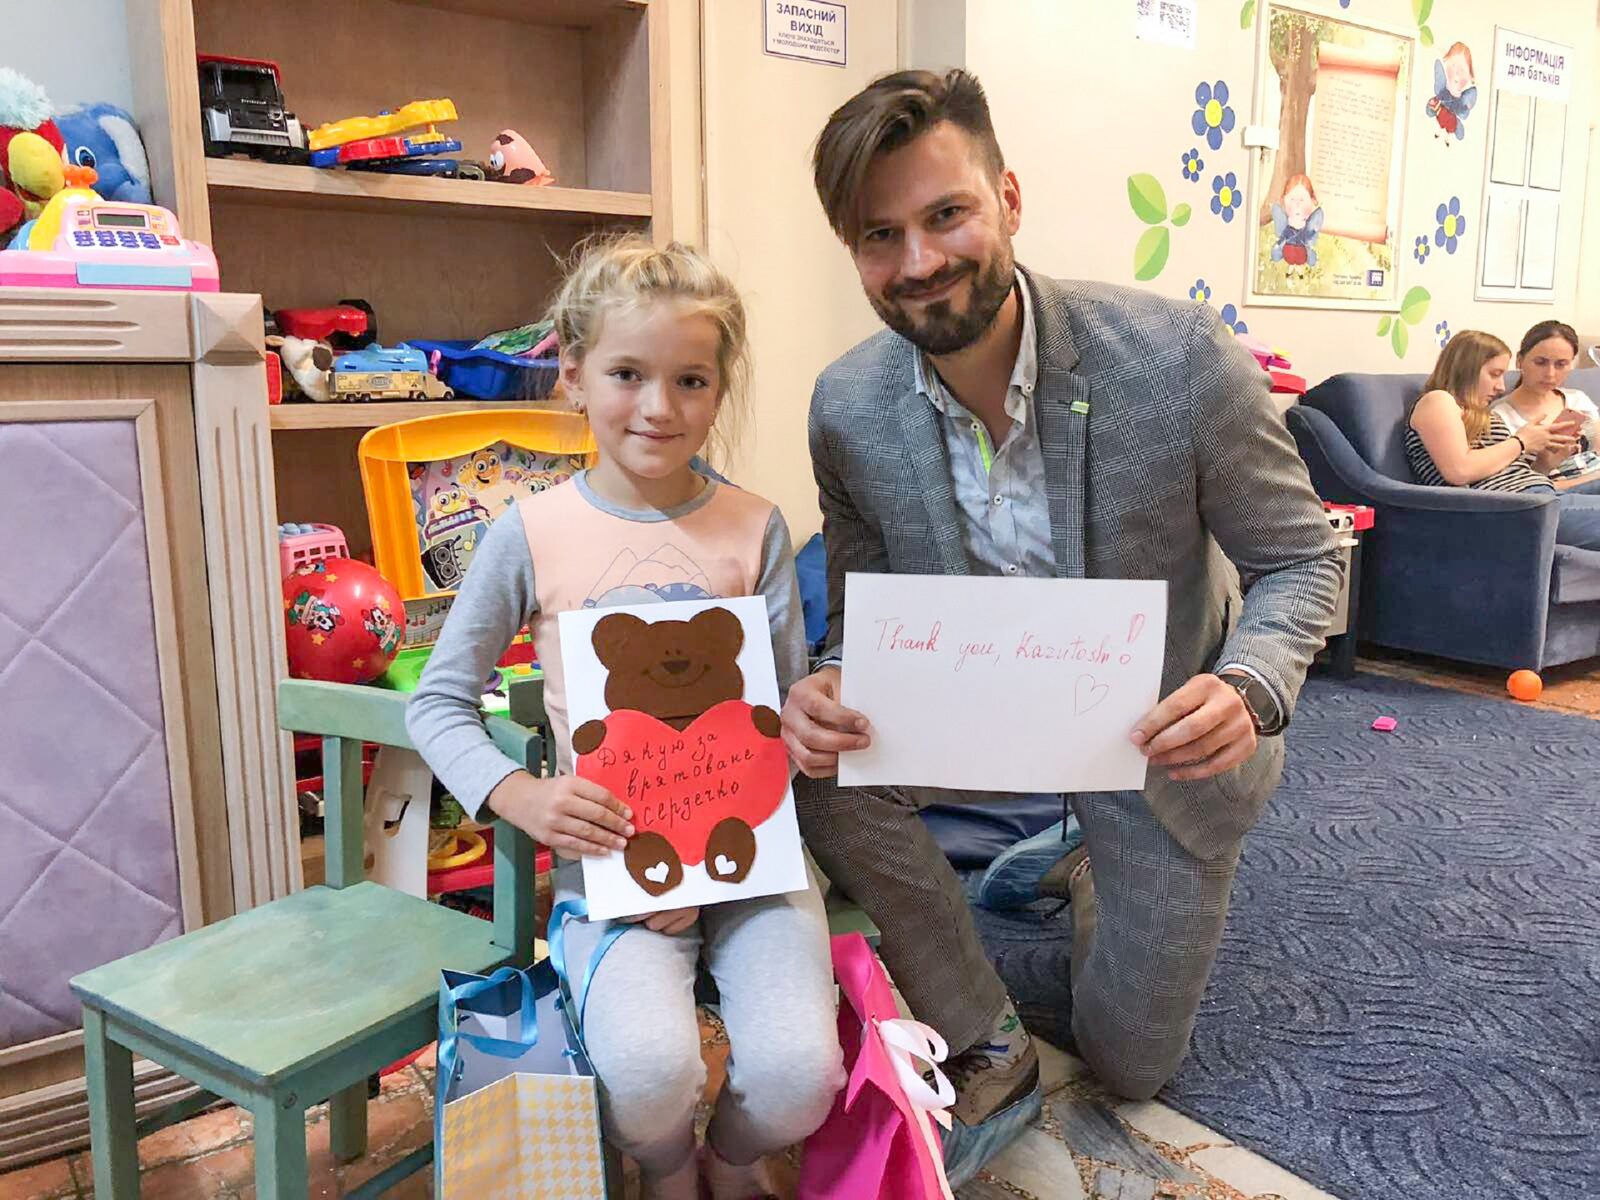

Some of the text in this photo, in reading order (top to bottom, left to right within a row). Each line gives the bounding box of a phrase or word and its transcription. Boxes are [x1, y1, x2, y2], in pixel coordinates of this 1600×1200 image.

[777, 3, 836, 23] ЗАПАСНИЙ
[790, 20, 823, 37] ВИХІД
[1506, 43, 1564, 70] ІНФОРМАЦІЯ
[1508, 64, 1560, 86] для батьків
[875, 617, 940, 652] Thank
[953, 641, 1001, 672] you,
[597, 733, 718, 770] Дякую за
[626, 749, 755, 801] врятоване
